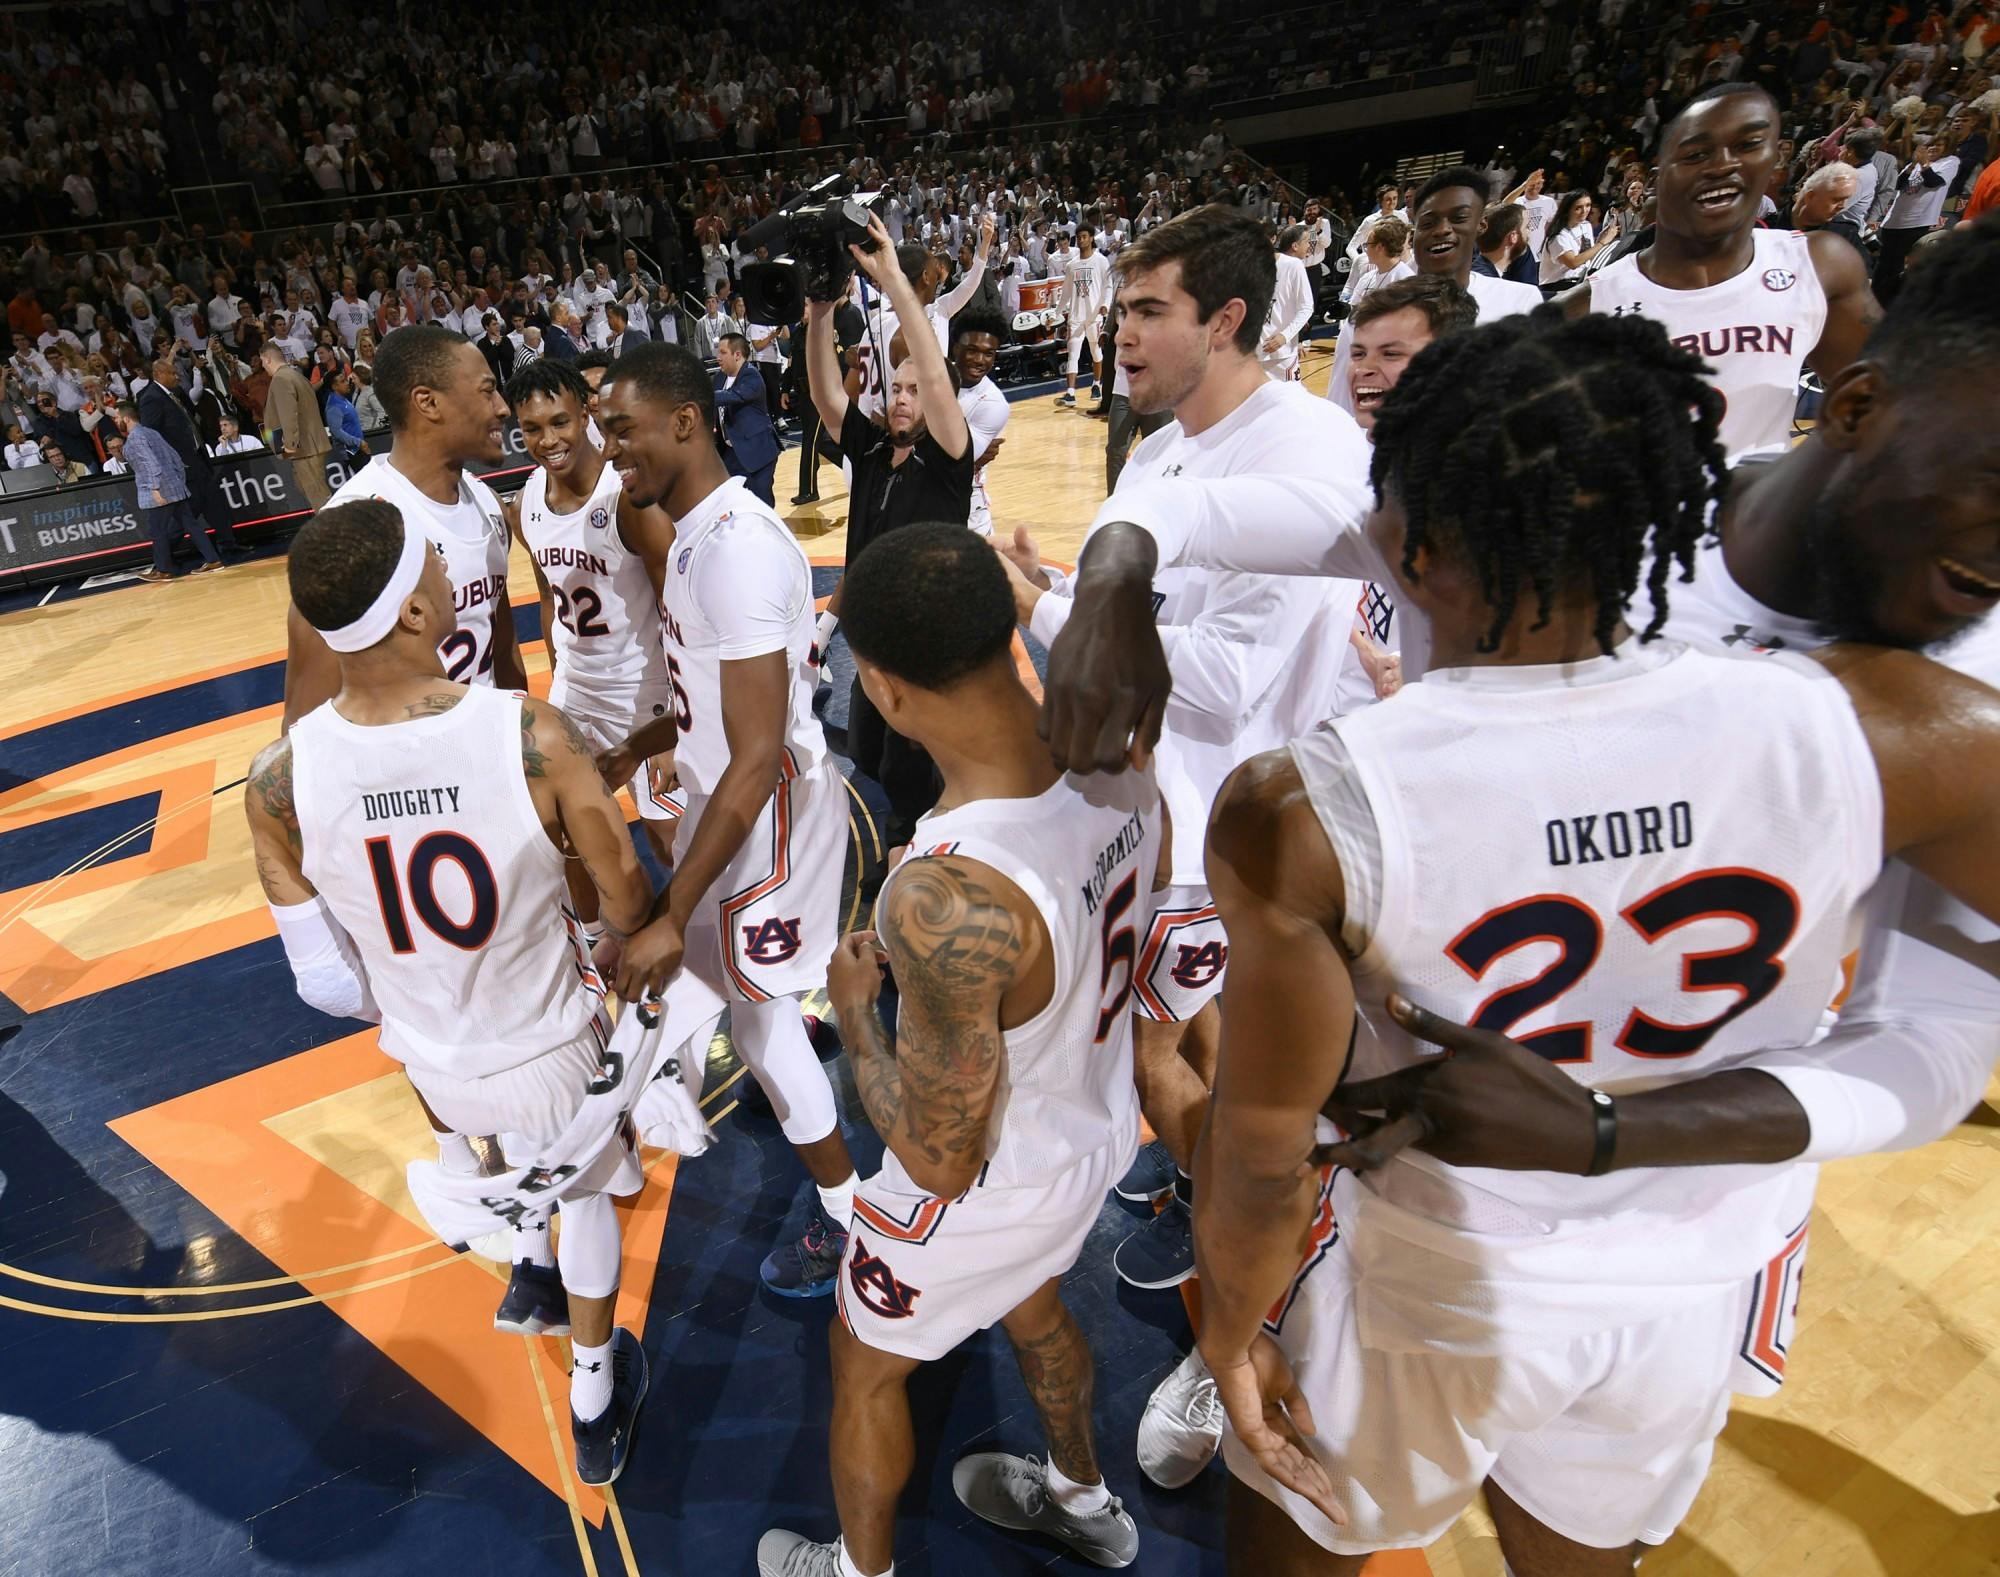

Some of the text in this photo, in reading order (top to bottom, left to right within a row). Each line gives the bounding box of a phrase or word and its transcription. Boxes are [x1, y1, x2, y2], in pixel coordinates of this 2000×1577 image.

[32, 499, 125, 527] inspiring
[219, 469, 286, 510] the
[37, 513, 138, 547] BUSINESS
[551, 583, 610, 637] 22
[362, 786, 460, 821] DOUGHTY
[1546, 800, 1693, 866] OKORO
[364, 829, 500, 955] 10
[1094, 866, 1138, 1043] 5
[1443, 865, 1802, 1064] 23
